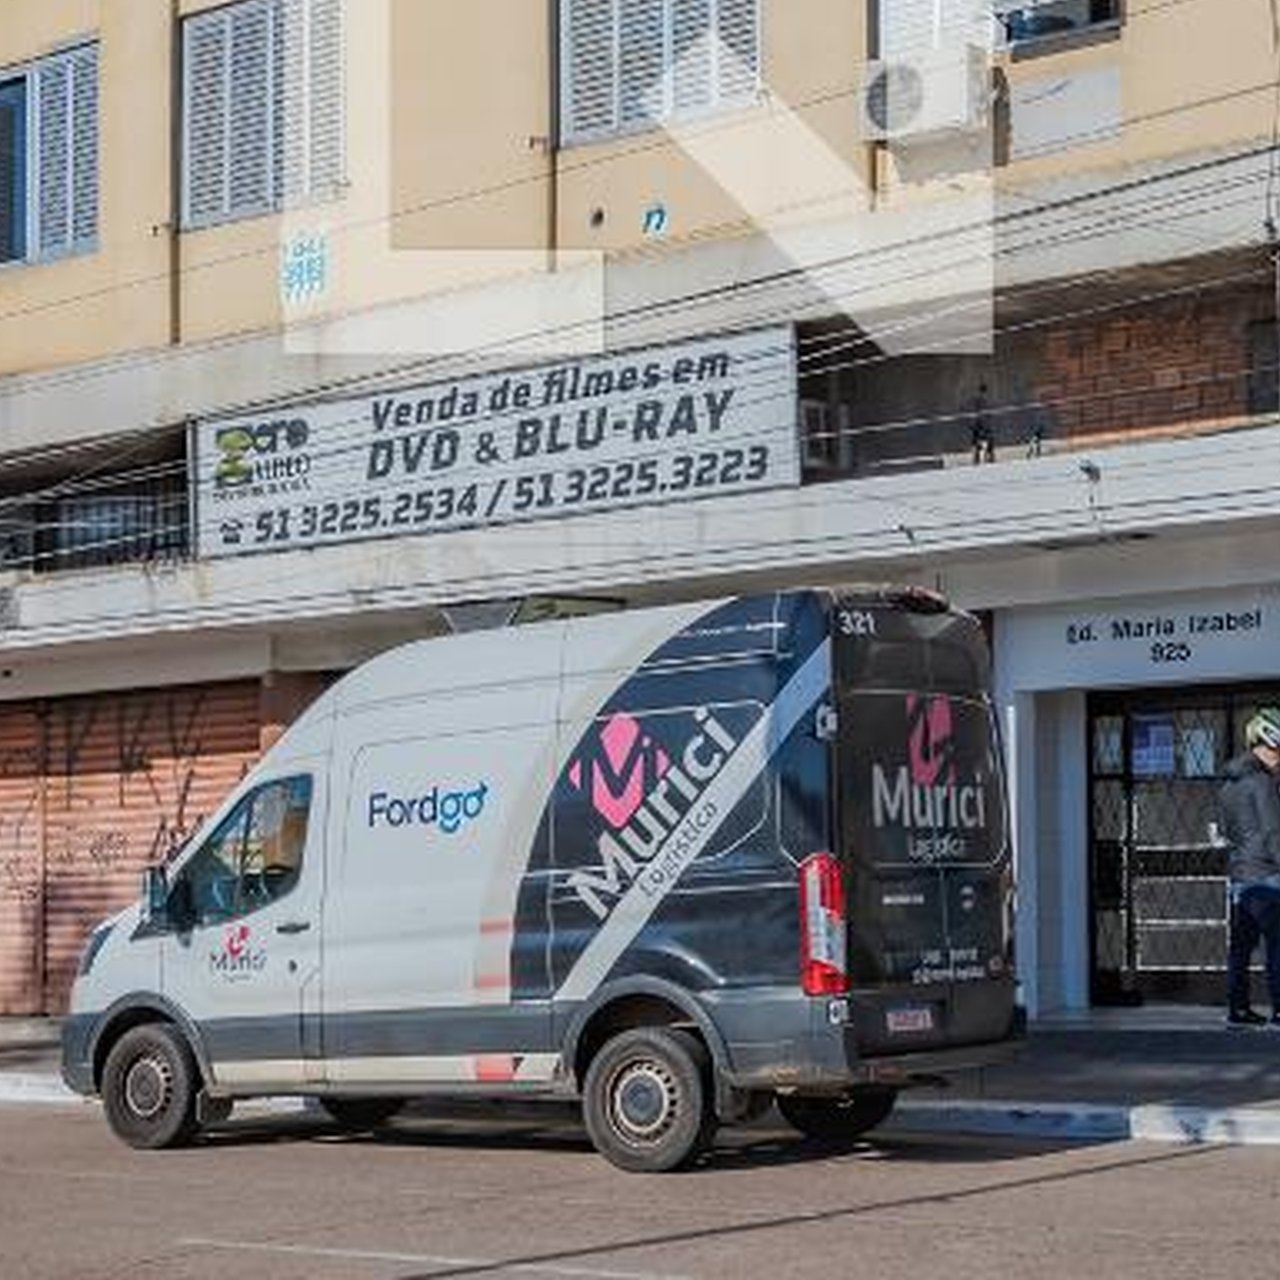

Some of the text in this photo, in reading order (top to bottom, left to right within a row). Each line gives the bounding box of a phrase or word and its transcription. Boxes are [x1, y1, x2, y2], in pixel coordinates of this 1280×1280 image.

[371, 351, 731, 431] Venda de filmes em
[367, 429, 461, 480] DVD
[475, 430, 501, 465] &
[514, 389, 736, 460] BLU-RAY
[512, 472, 555, 511] 51
[563, 445, 770, 504] 3225.3223
[839, 609, 877, 635] 321
[1111, 618, 1175, 639] Maria
[1188, 609, 1263, 634] Izabel
[1150, 642, 1192, 663] 925
[565, 705, 738, 922] Murici
[872, 763, 986, 828] Murici
